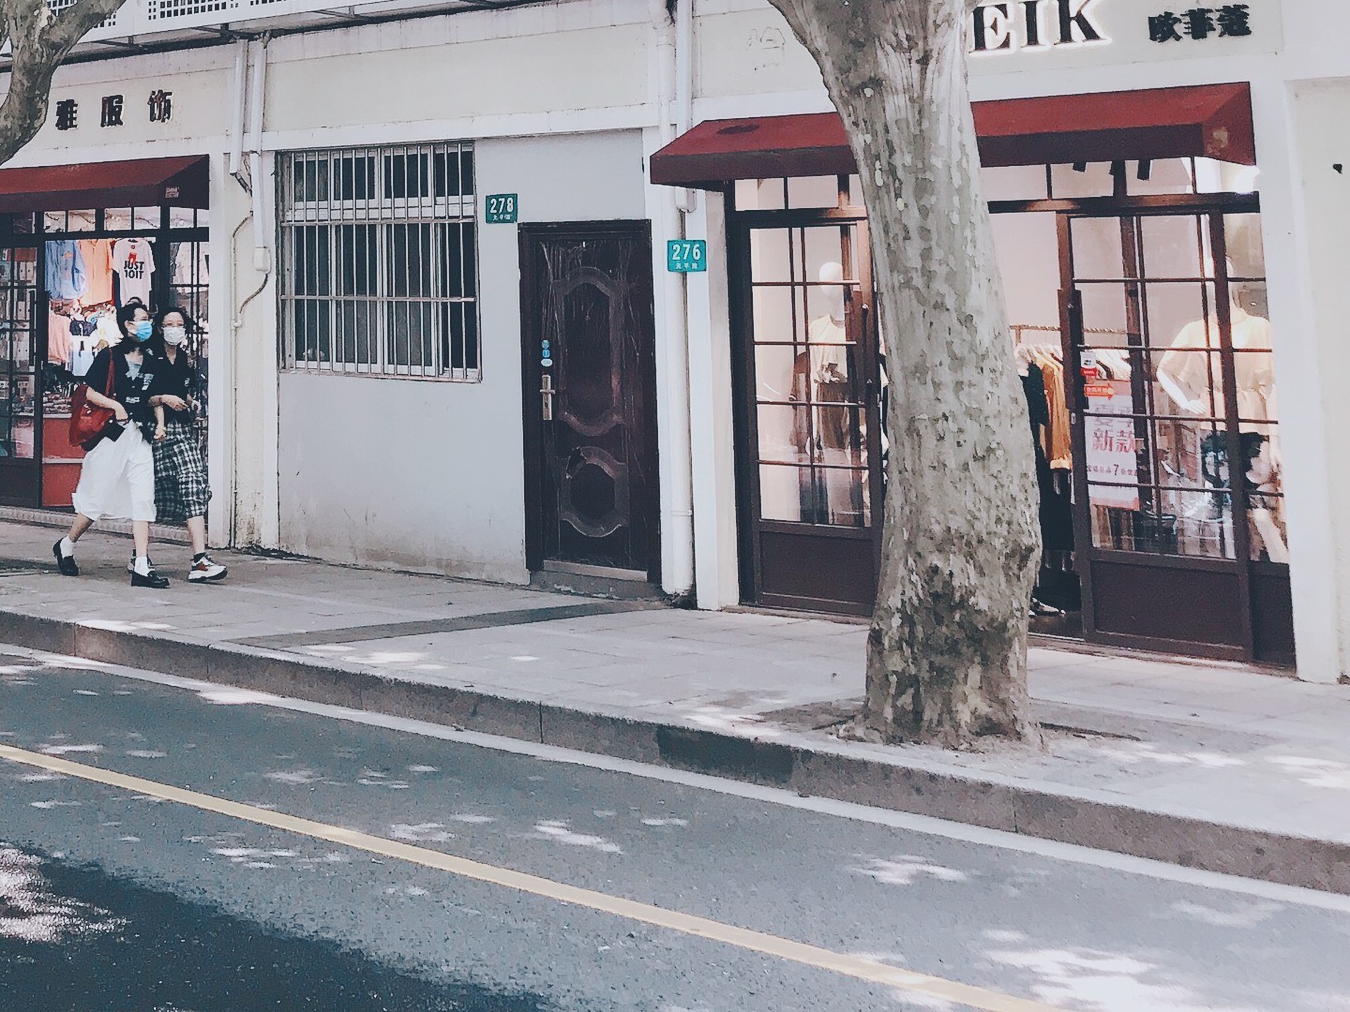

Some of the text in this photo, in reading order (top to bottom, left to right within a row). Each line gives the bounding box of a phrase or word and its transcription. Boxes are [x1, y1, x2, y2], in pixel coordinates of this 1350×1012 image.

[489, 197, 514, 214] 278
[672, 243, 701, 261] 276
[1092, 428, 1136, 453] 新款
